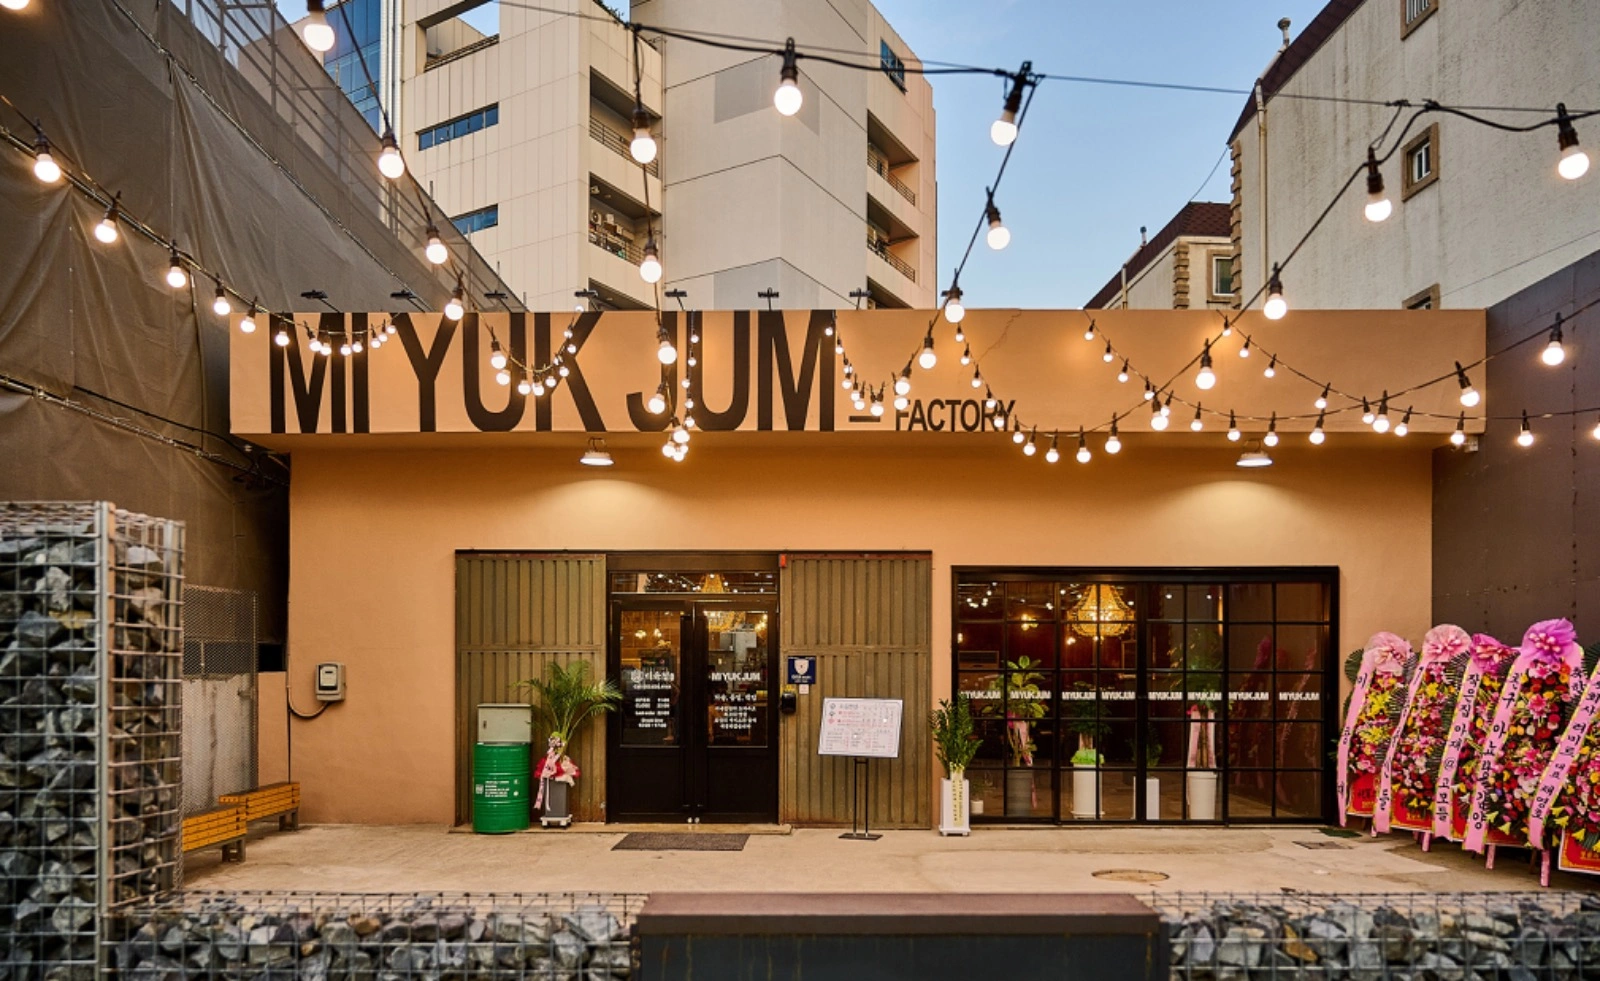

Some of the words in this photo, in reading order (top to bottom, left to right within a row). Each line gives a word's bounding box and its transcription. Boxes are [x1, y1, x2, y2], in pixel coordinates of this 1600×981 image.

[626, 310, 836, 431] JUM
[895, 399, 1015, 432] FACTORY
[1460, 673, 1480, 718] 작은집
